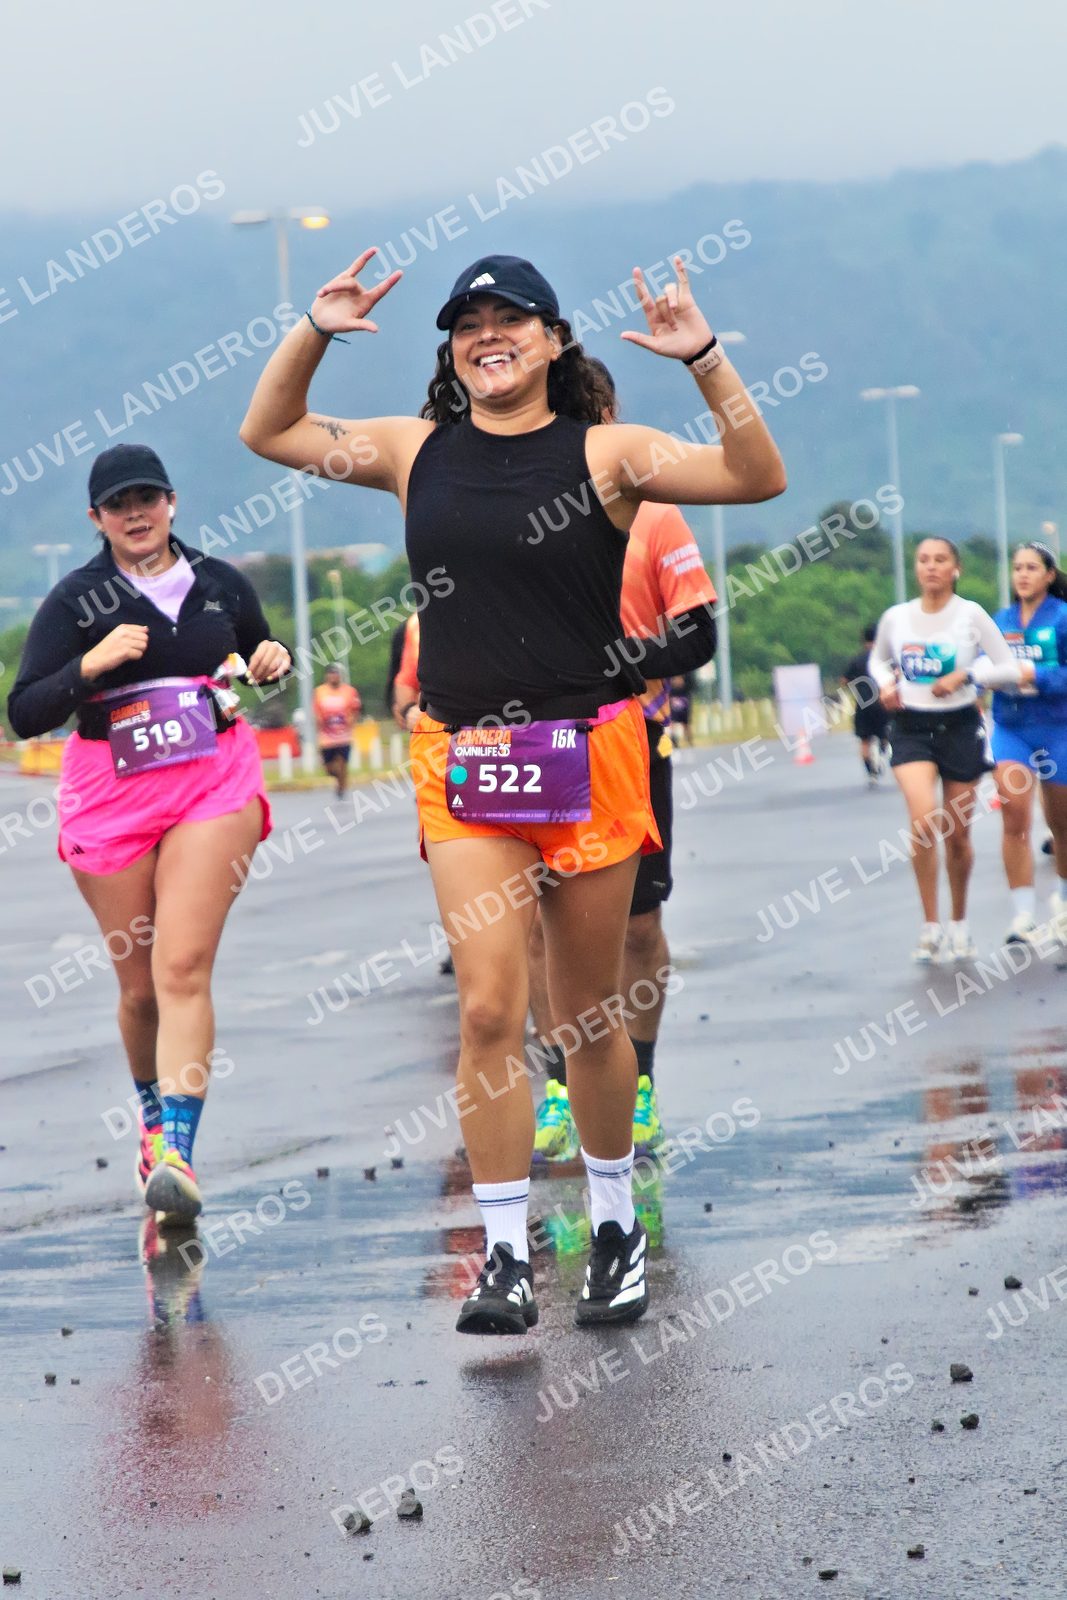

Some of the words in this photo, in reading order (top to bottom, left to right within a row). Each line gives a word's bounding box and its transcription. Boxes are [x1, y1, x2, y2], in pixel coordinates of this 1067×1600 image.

[133, 719, 182, 752] 519
[456, 729, 512, 746] CARRERA
[551, 728, 577, 749] 15K
[478, 764, 542, 793] 522
